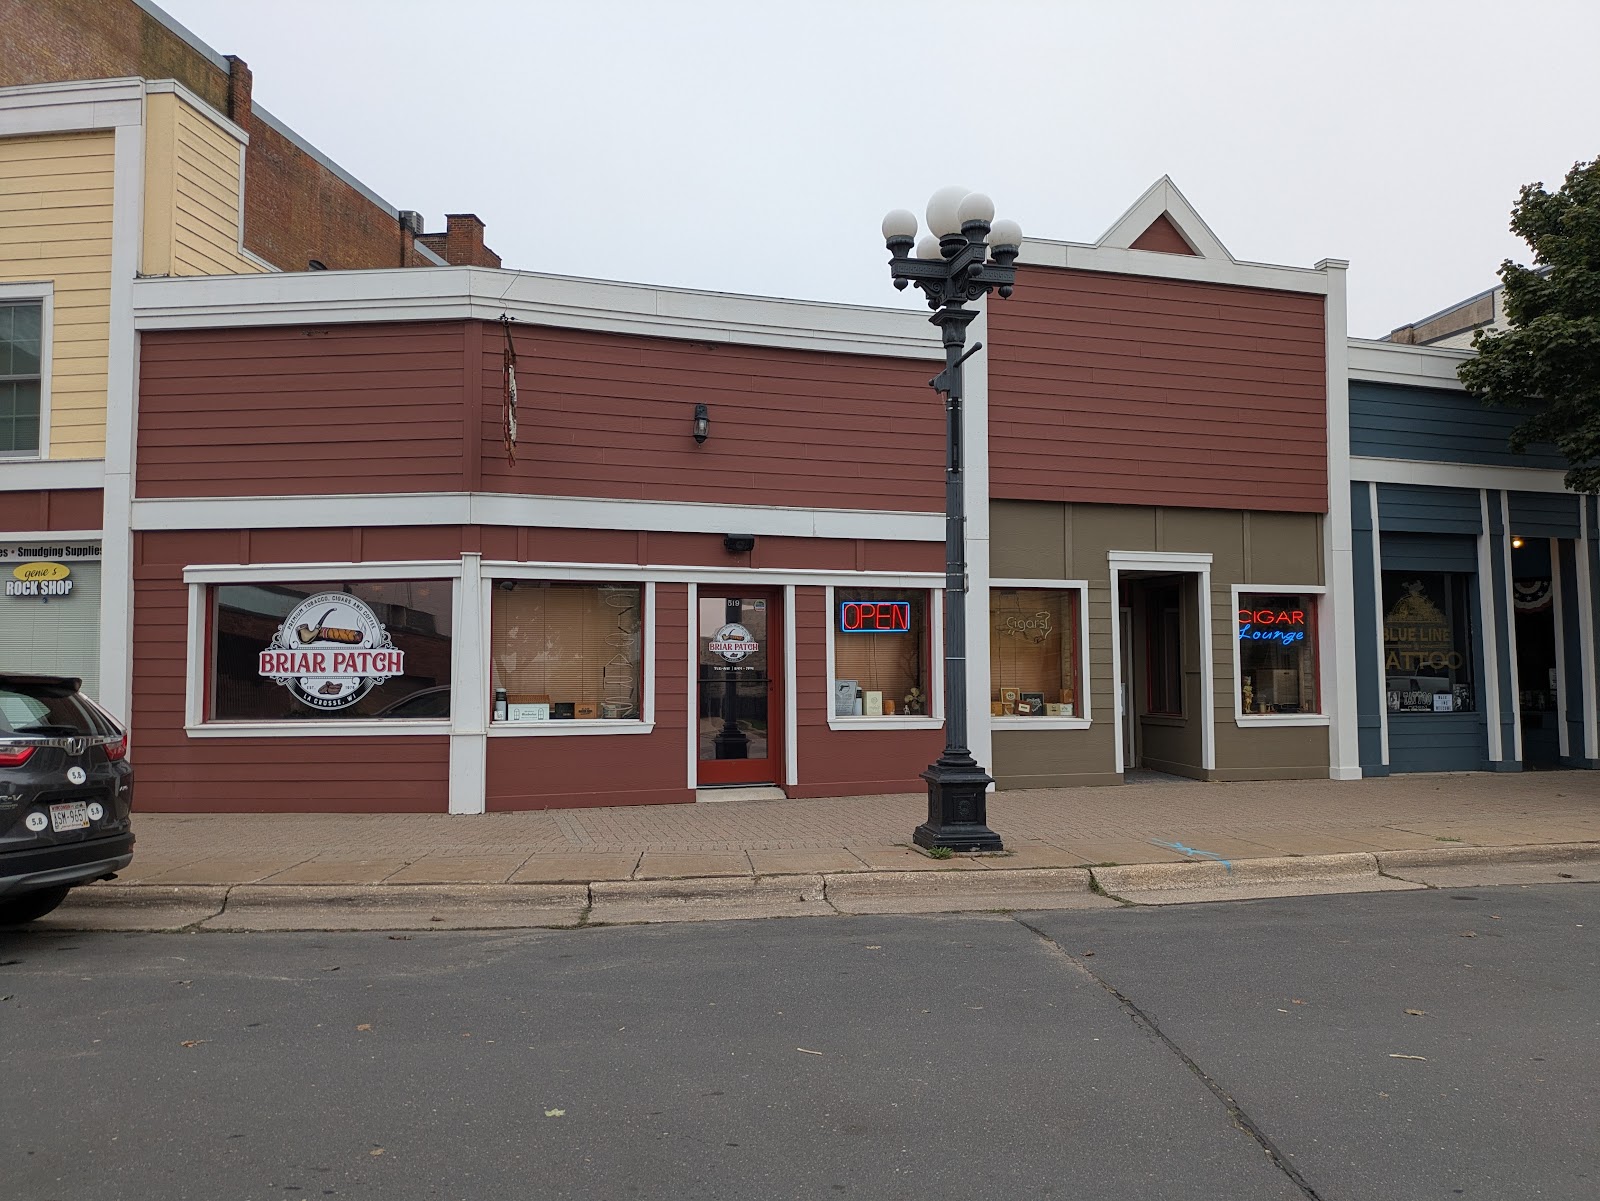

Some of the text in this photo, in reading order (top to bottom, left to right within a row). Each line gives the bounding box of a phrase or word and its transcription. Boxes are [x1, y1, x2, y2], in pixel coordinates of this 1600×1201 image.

[18, 546, 63, 558] Smudging
[6, 580, 73, 596] ROCK SHOP
[287, 608, 305, 630] PREMIUM
[331, 595, 352, 604] CIGARS
[844, 603, 908, 630] OPEN
[1238, 609, 1304, 625] CIGAR
[1006, 616, 1046, 632] Cigars
[1238, 624, 1304, 645] Lounge
[1384, 627, 1451, 642] BLUE LINE
[709, 643, 758, 651] BRIAR PATCH
[260, 652, 401, 674] BRIAR PATCH
[1385, 651, 1462, 670] ATTOO
[31, 818, 43, 826] 5.8
